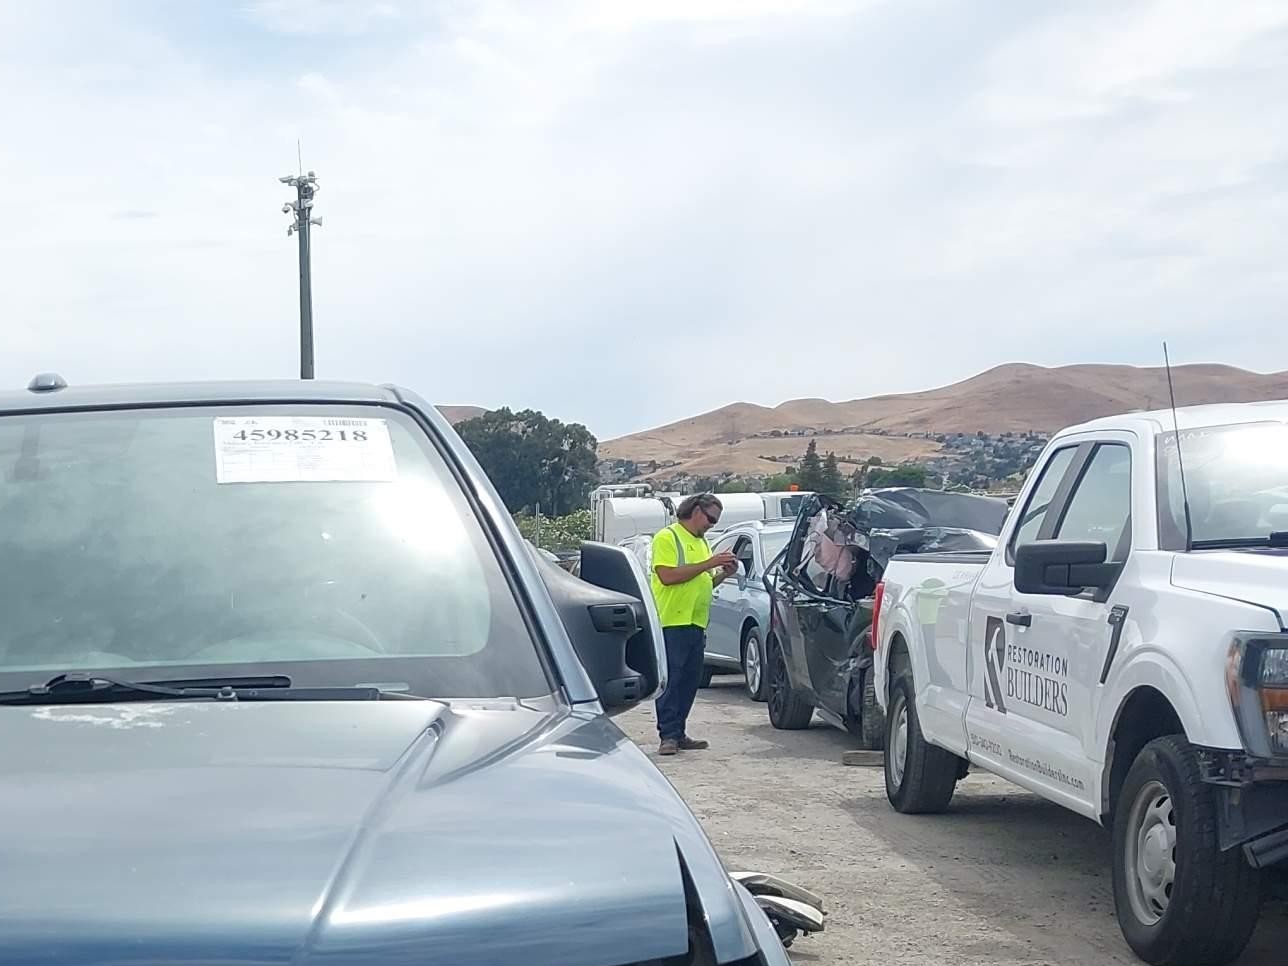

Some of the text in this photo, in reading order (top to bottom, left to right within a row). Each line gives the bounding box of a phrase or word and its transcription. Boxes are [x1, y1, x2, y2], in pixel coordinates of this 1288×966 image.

[232, 428, 368, 441] 45985218
[1007, 644, 1068, 677] RESTORATION
[1007, 666, 1068, 717] BUILDERS
